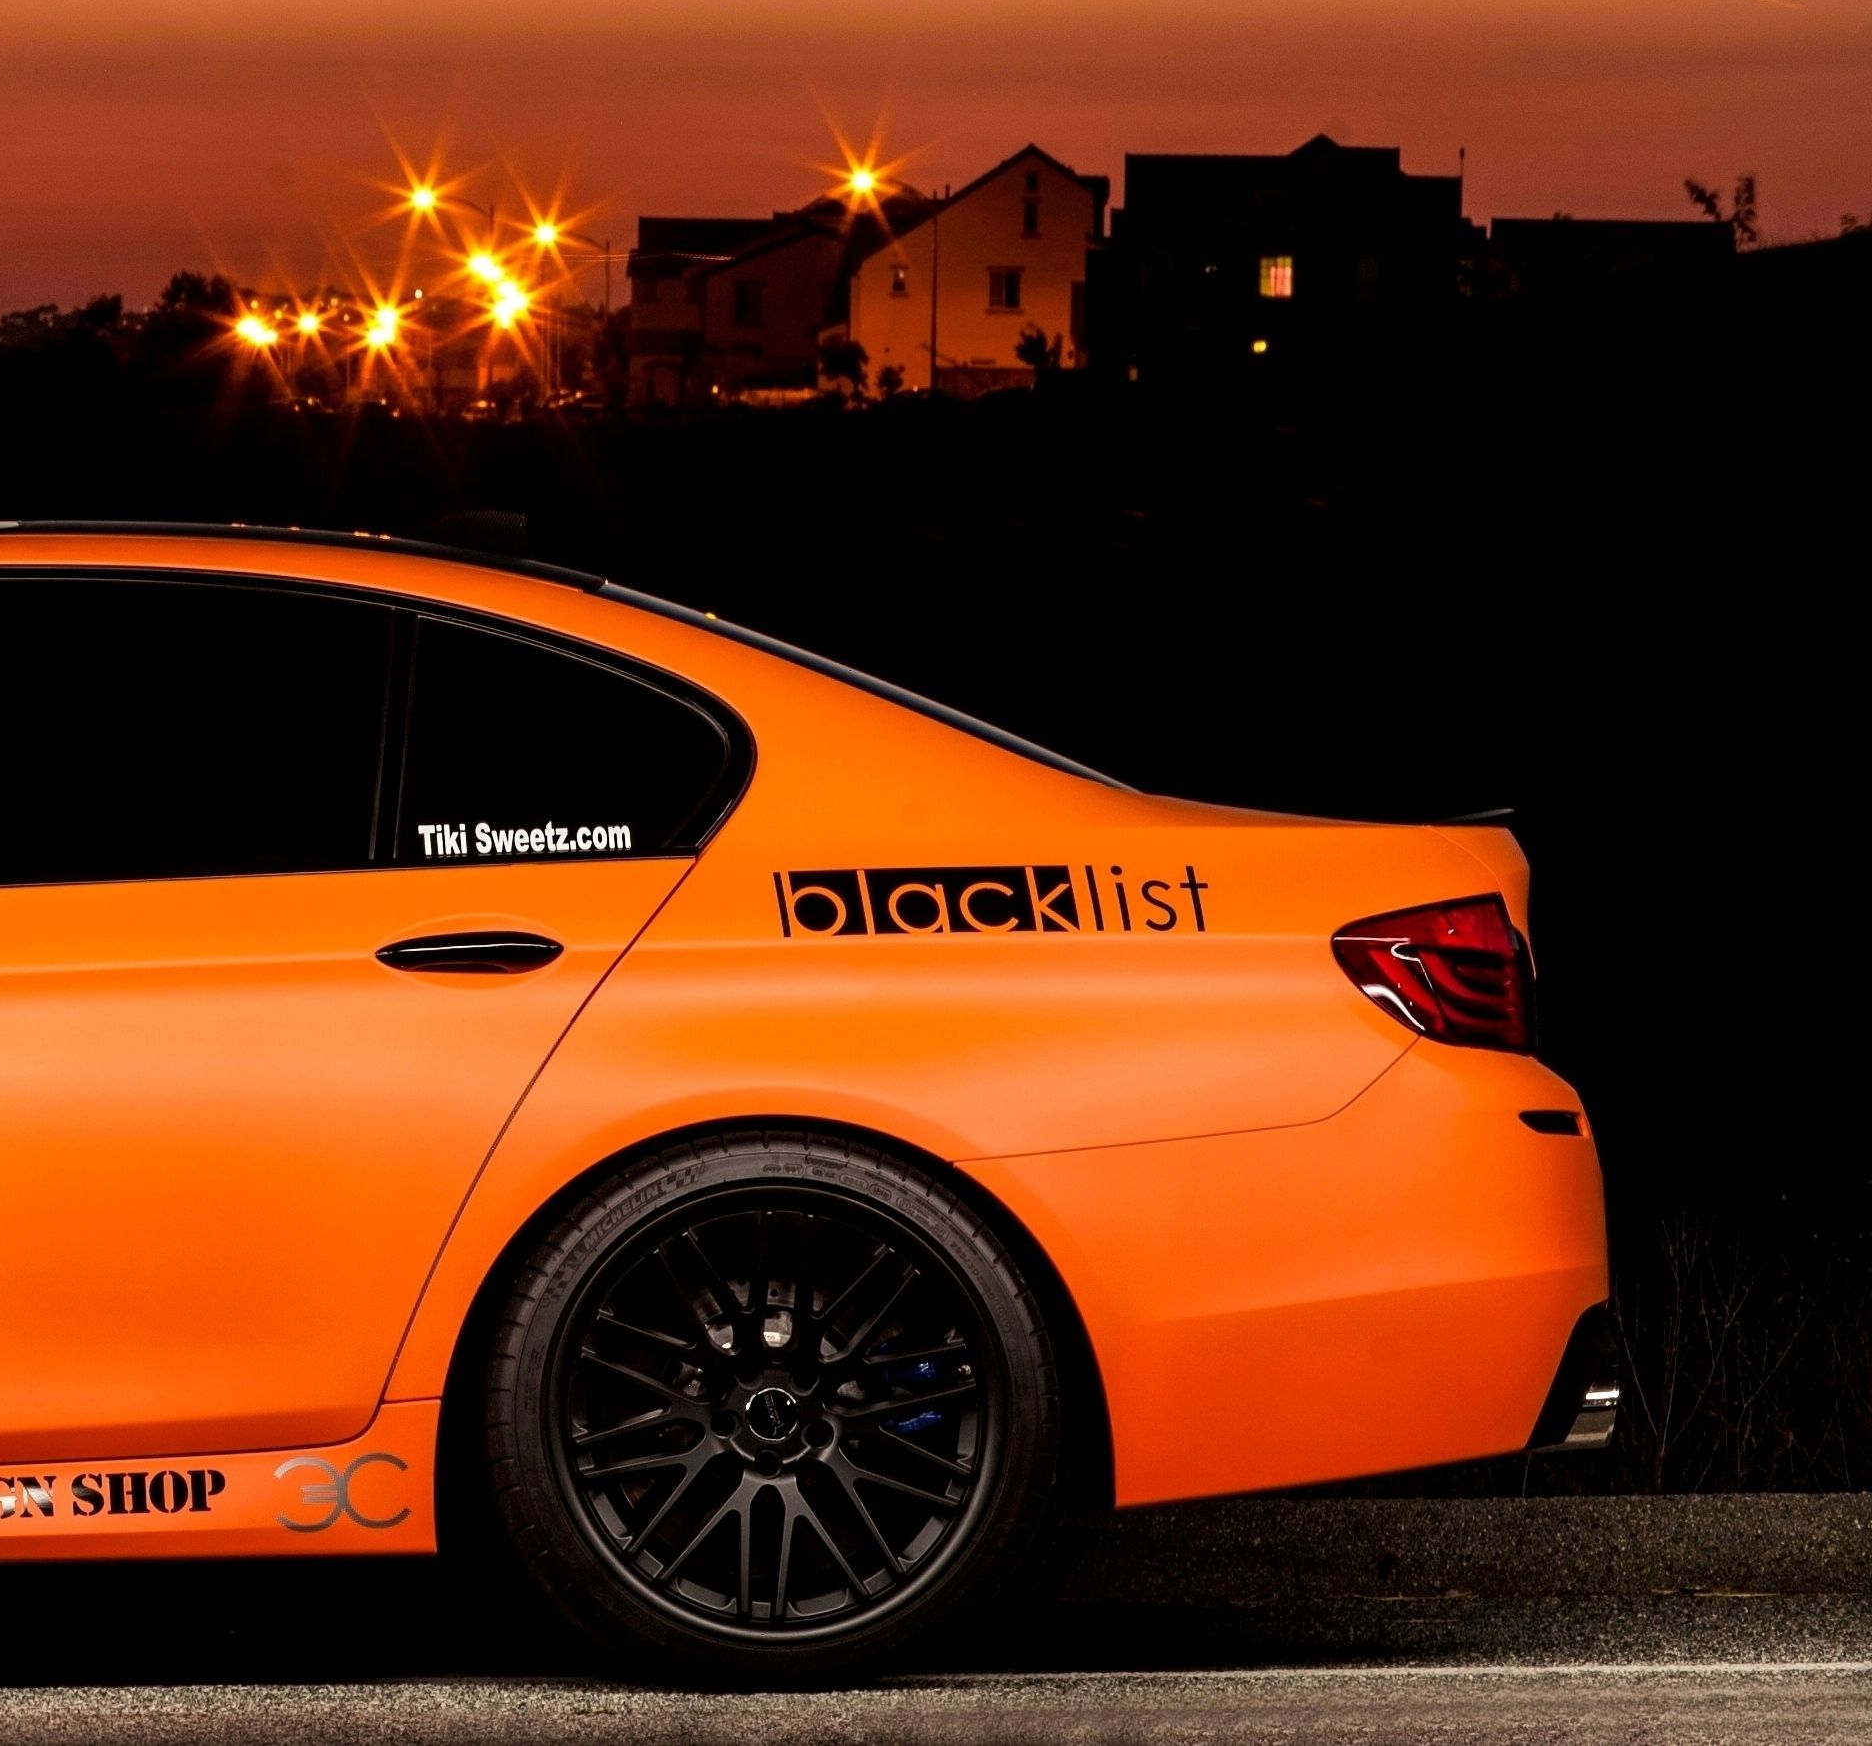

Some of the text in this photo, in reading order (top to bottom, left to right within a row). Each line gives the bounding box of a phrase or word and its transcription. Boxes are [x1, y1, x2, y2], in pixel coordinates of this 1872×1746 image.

[418, 820, 632, 856] Tiki Sweetz.com
[773, 864, 1209, 938] blacklist
[583, 1181, 664, 1249] MICHELIN
[72, 1469, 226, 1516] SHOP
